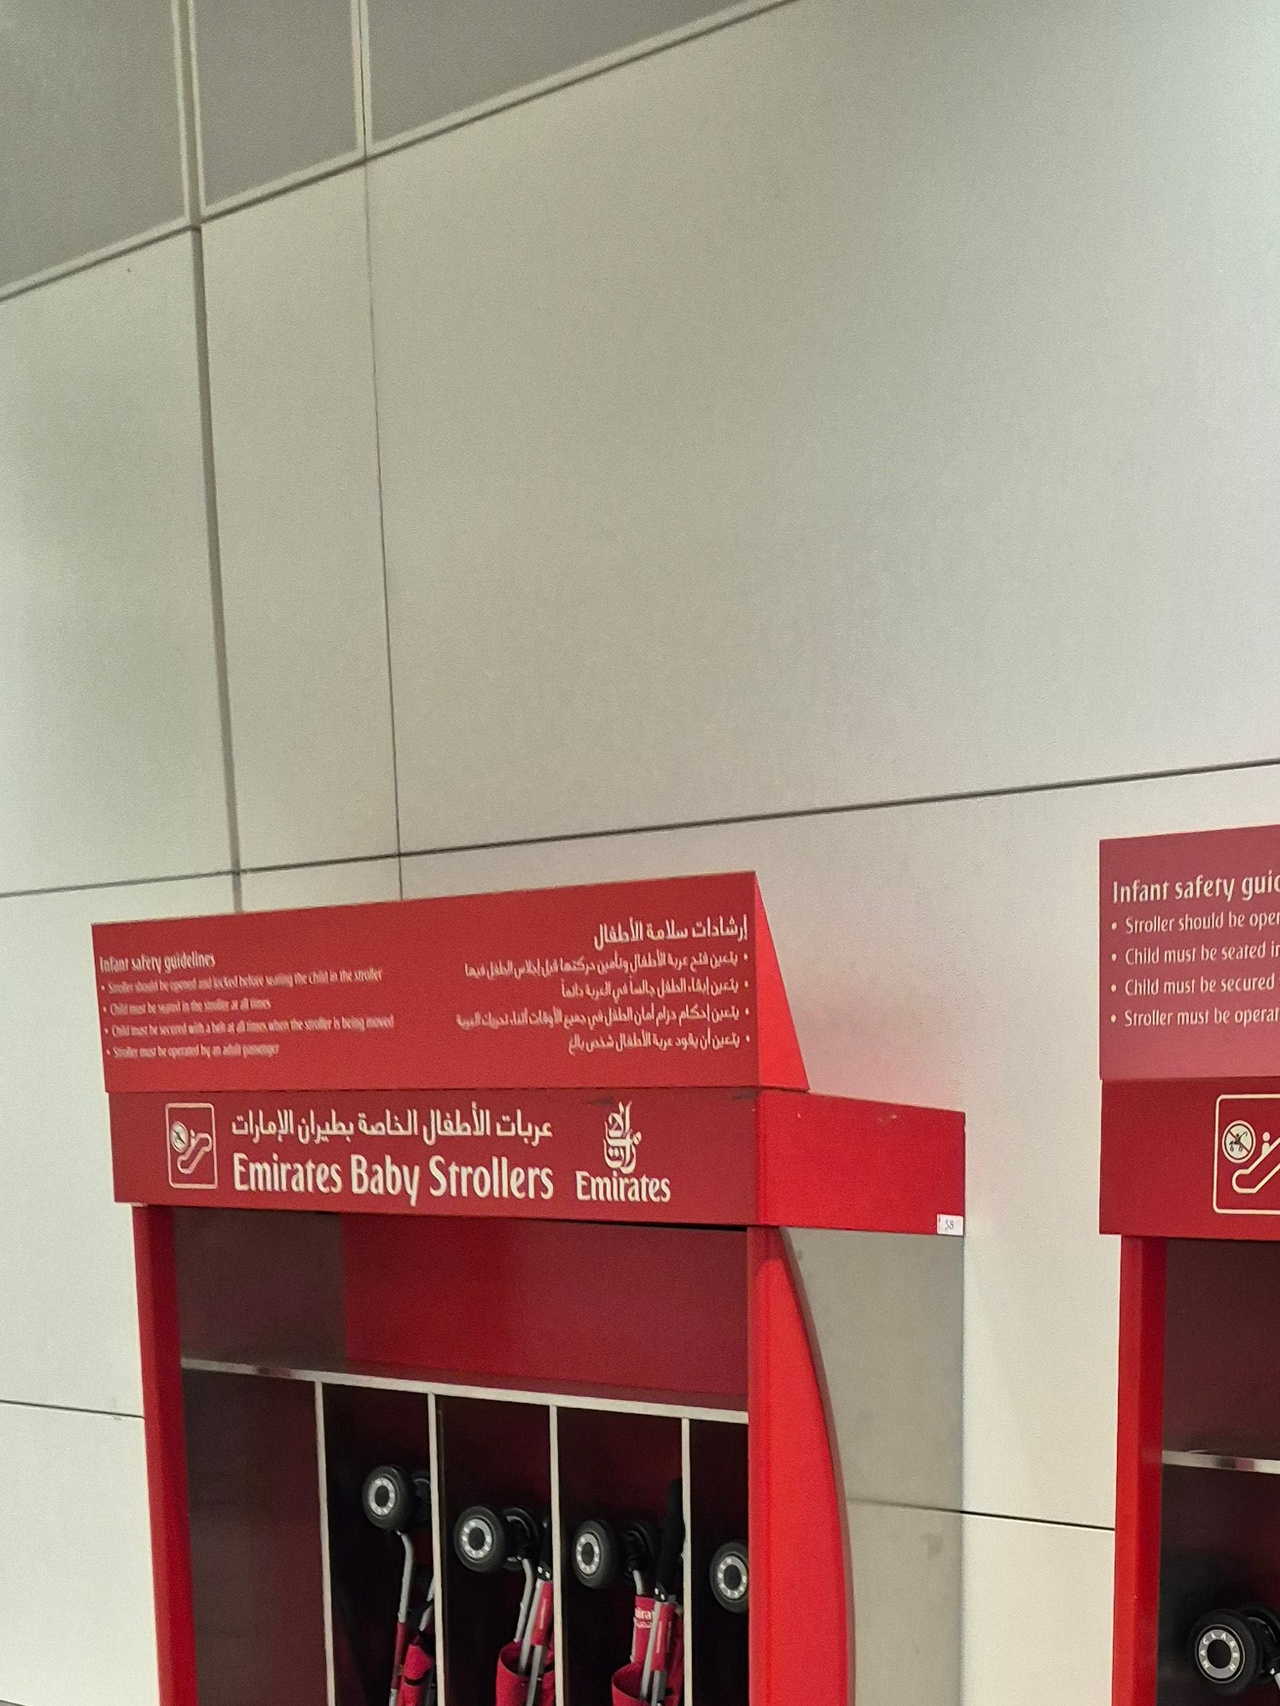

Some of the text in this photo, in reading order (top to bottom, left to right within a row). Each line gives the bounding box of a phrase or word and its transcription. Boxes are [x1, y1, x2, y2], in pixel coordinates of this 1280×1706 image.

[1114, 880, 1169, 903] Infant
[1175, 875, 1235, 901] safety
[594, 914, 748, 950] إرشادات سلامة الأطفال
[1126, 916, 1174, 933] Stroller
[1179, 912, 1223, 931] should
[1229, 911, 1245, 927] be
[99, 950, 216, 974] Infant safety guidelines
[1126, 947, 1159, 965] Child
[1164, 948, 1196, 963] must
[1201, 945, 1217, 961] be
[1222, 941, 1266, 960] seated
[1125, 978, 1159, 995] Child
[1164, 979, 1195, 994] must
[1200, 976, 1216, 993] be
[1221, 973, 1275, 992] secured
[1125, 1010, 1173, 1026] Stroller
[1177, 1010, 1209, 1025] must
[1214, 1008, 1230, 1023] be
[231, 1101, 553, 1146] عربات الأطفال الخاصة بطيران الإمارات
[233, 1152, 554, 1207] Emirates Baby Strollers
[575, 1170, 671, 1202] Emirates
